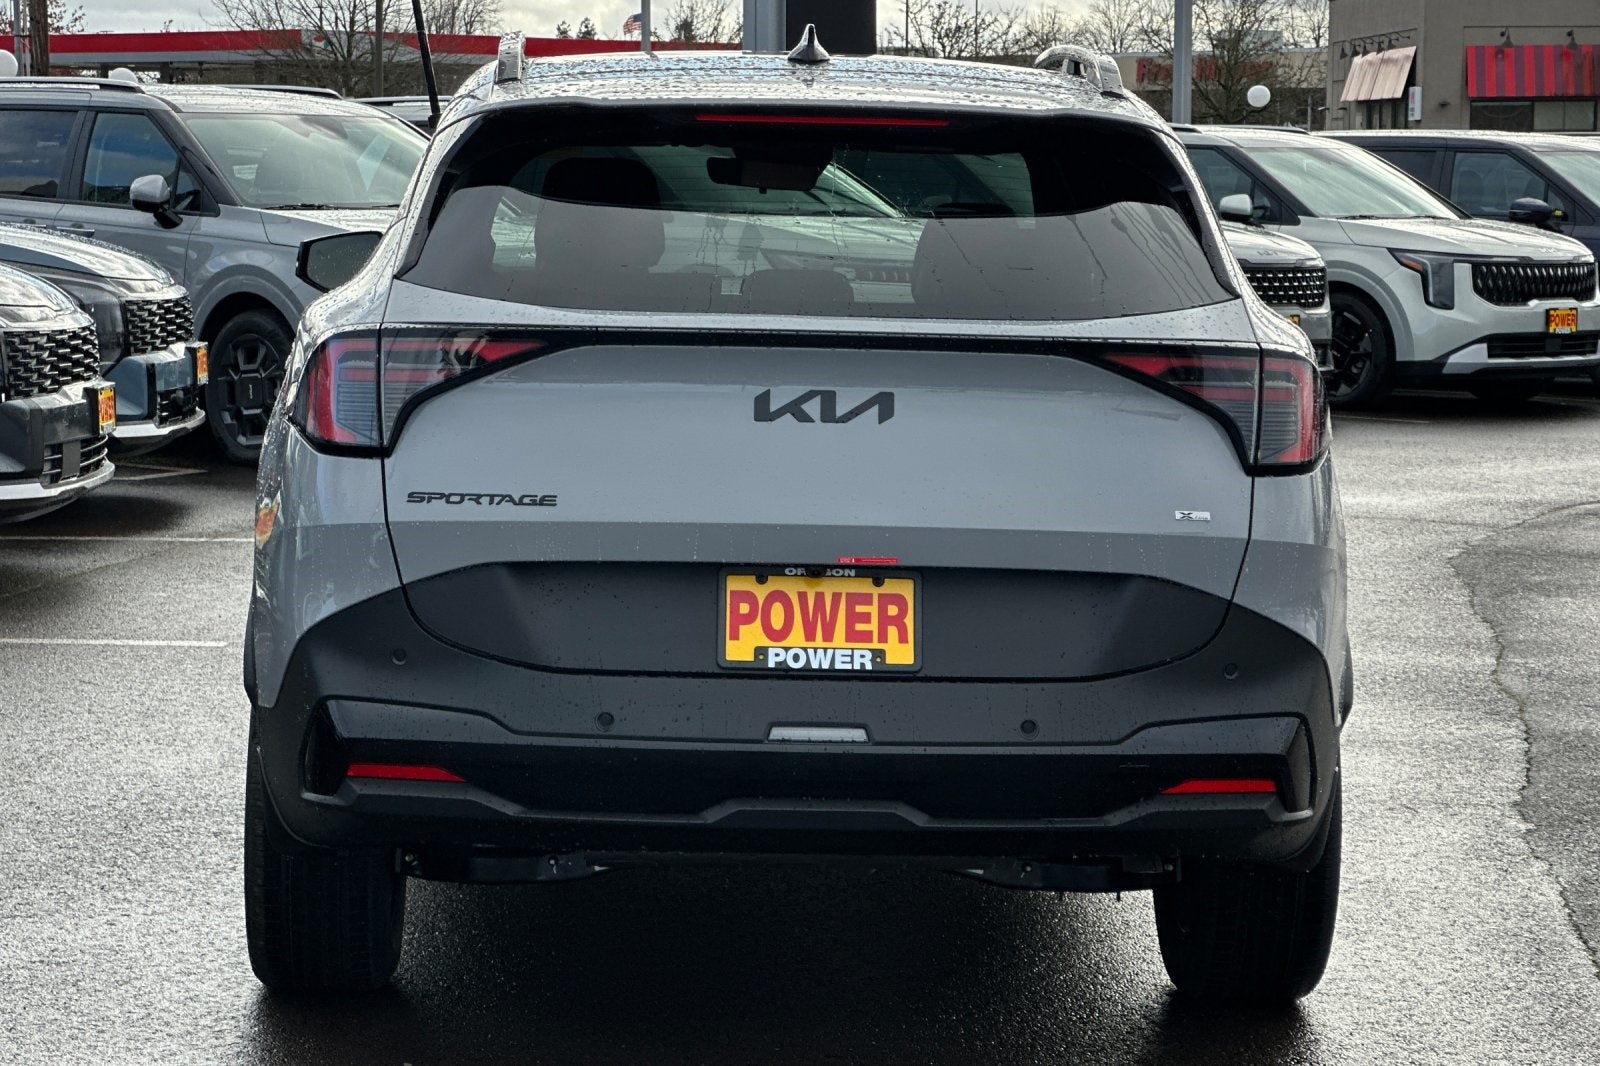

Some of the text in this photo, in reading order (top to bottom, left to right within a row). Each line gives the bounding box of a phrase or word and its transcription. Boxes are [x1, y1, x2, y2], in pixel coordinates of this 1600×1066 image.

[1550, 313, 1576, 327] POWER
[754, 388, 895, 424] KIA
[406, 491, 558, 507] SPORTAGE
[784, 567, 856, 577] ORON
[729, 589, 909, 644] POWER
[767, 647, 873, 670] POWER
